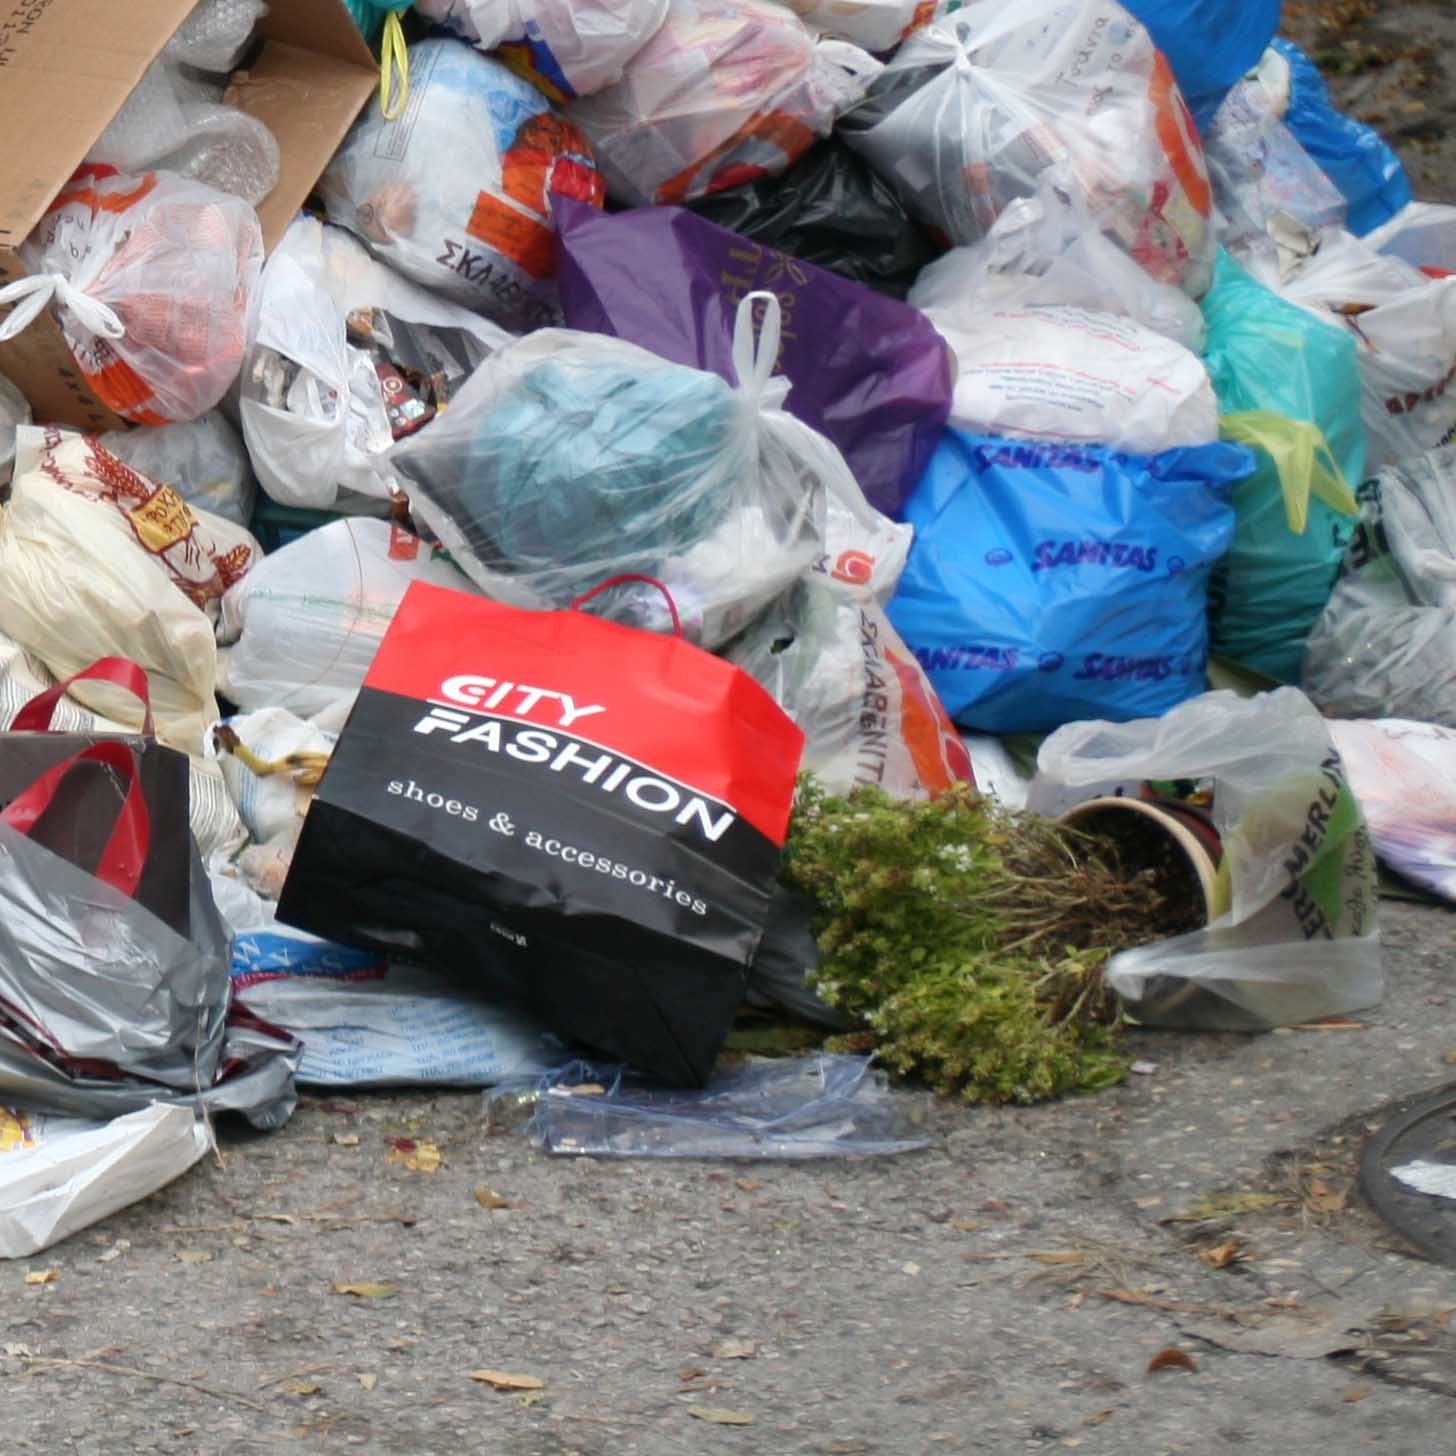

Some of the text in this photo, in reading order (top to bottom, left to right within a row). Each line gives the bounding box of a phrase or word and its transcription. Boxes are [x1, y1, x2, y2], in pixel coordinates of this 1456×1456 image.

[1030, 540, 1158, 574] SANITAS
[914, 647, 1022, 672] ANITAS
[439, 672, 606, 728] CITY
[413, 708, 738, 844] FASHION
[387, 773, 708, 917] shoes & accessories
